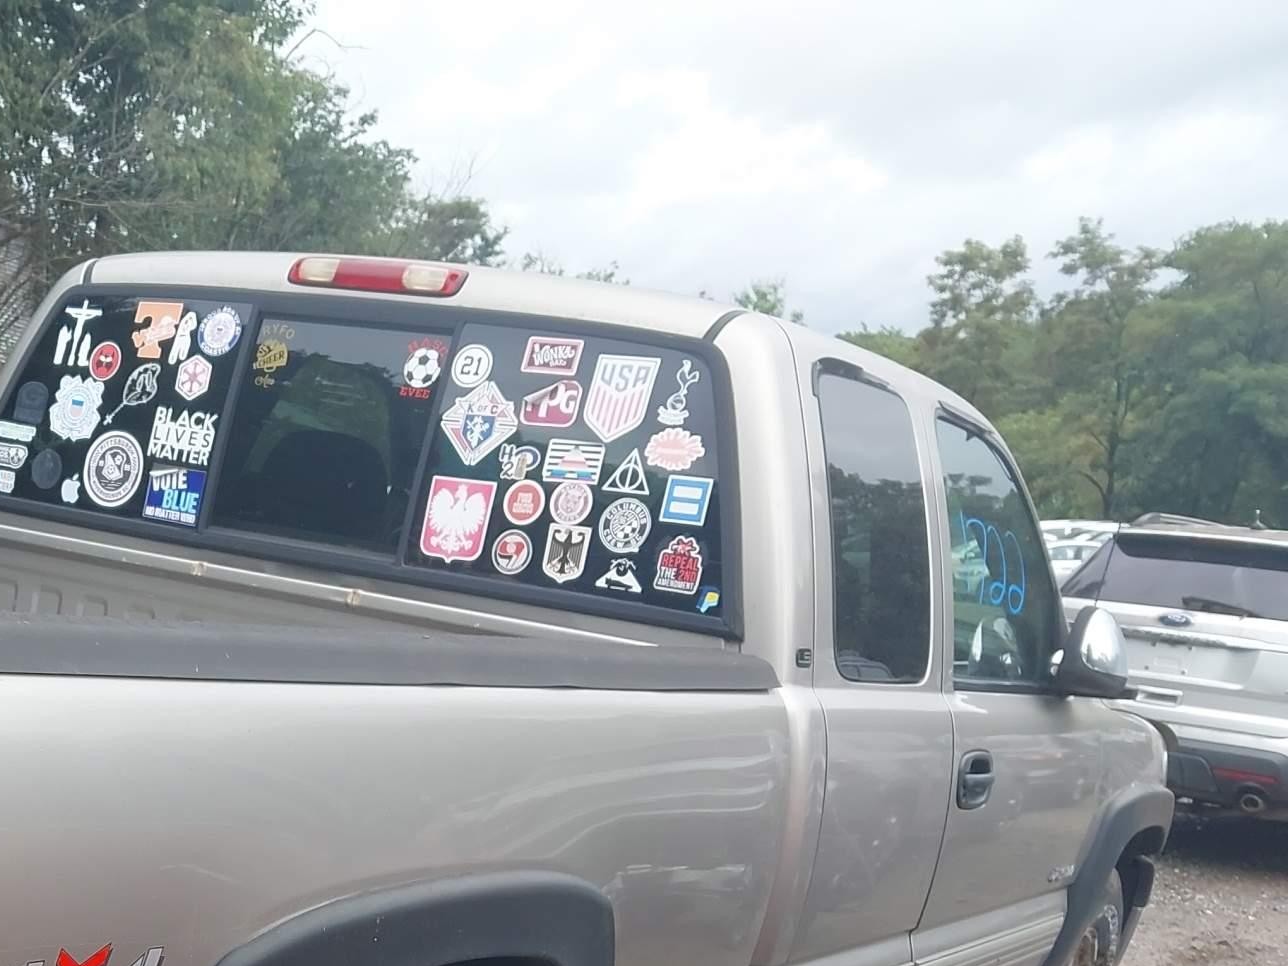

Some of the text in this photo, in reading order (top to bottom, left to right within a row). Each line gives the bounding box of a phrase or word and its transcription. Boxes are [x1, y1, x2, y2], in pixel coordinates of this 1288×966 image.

[259, 350, 285, 367] CHEER
[460, 355, 482, 376] 21
[532, 343, 575, 366] WONKA
[601, 363, 652, 392] USA
[490, 404, 499, 415] C
[526, 383, 578, 418] PG
[153, 405, 218, 431] BLACK
[153, 425, 211, 449] LIVES
[146, 442, 210, 466] MATTER
[152, 470, 188, 491] VOTE
[162, 489, 200, 514] BLUE
[606, 502, 647, 525] COLUMBUS
[603, 528, 625, 548] CREW
[661, 553, 698, 572] REPEAL
[657, 578, 694, 590] AMENDMENT
[660, 566, 697, 583] THE 2ND
